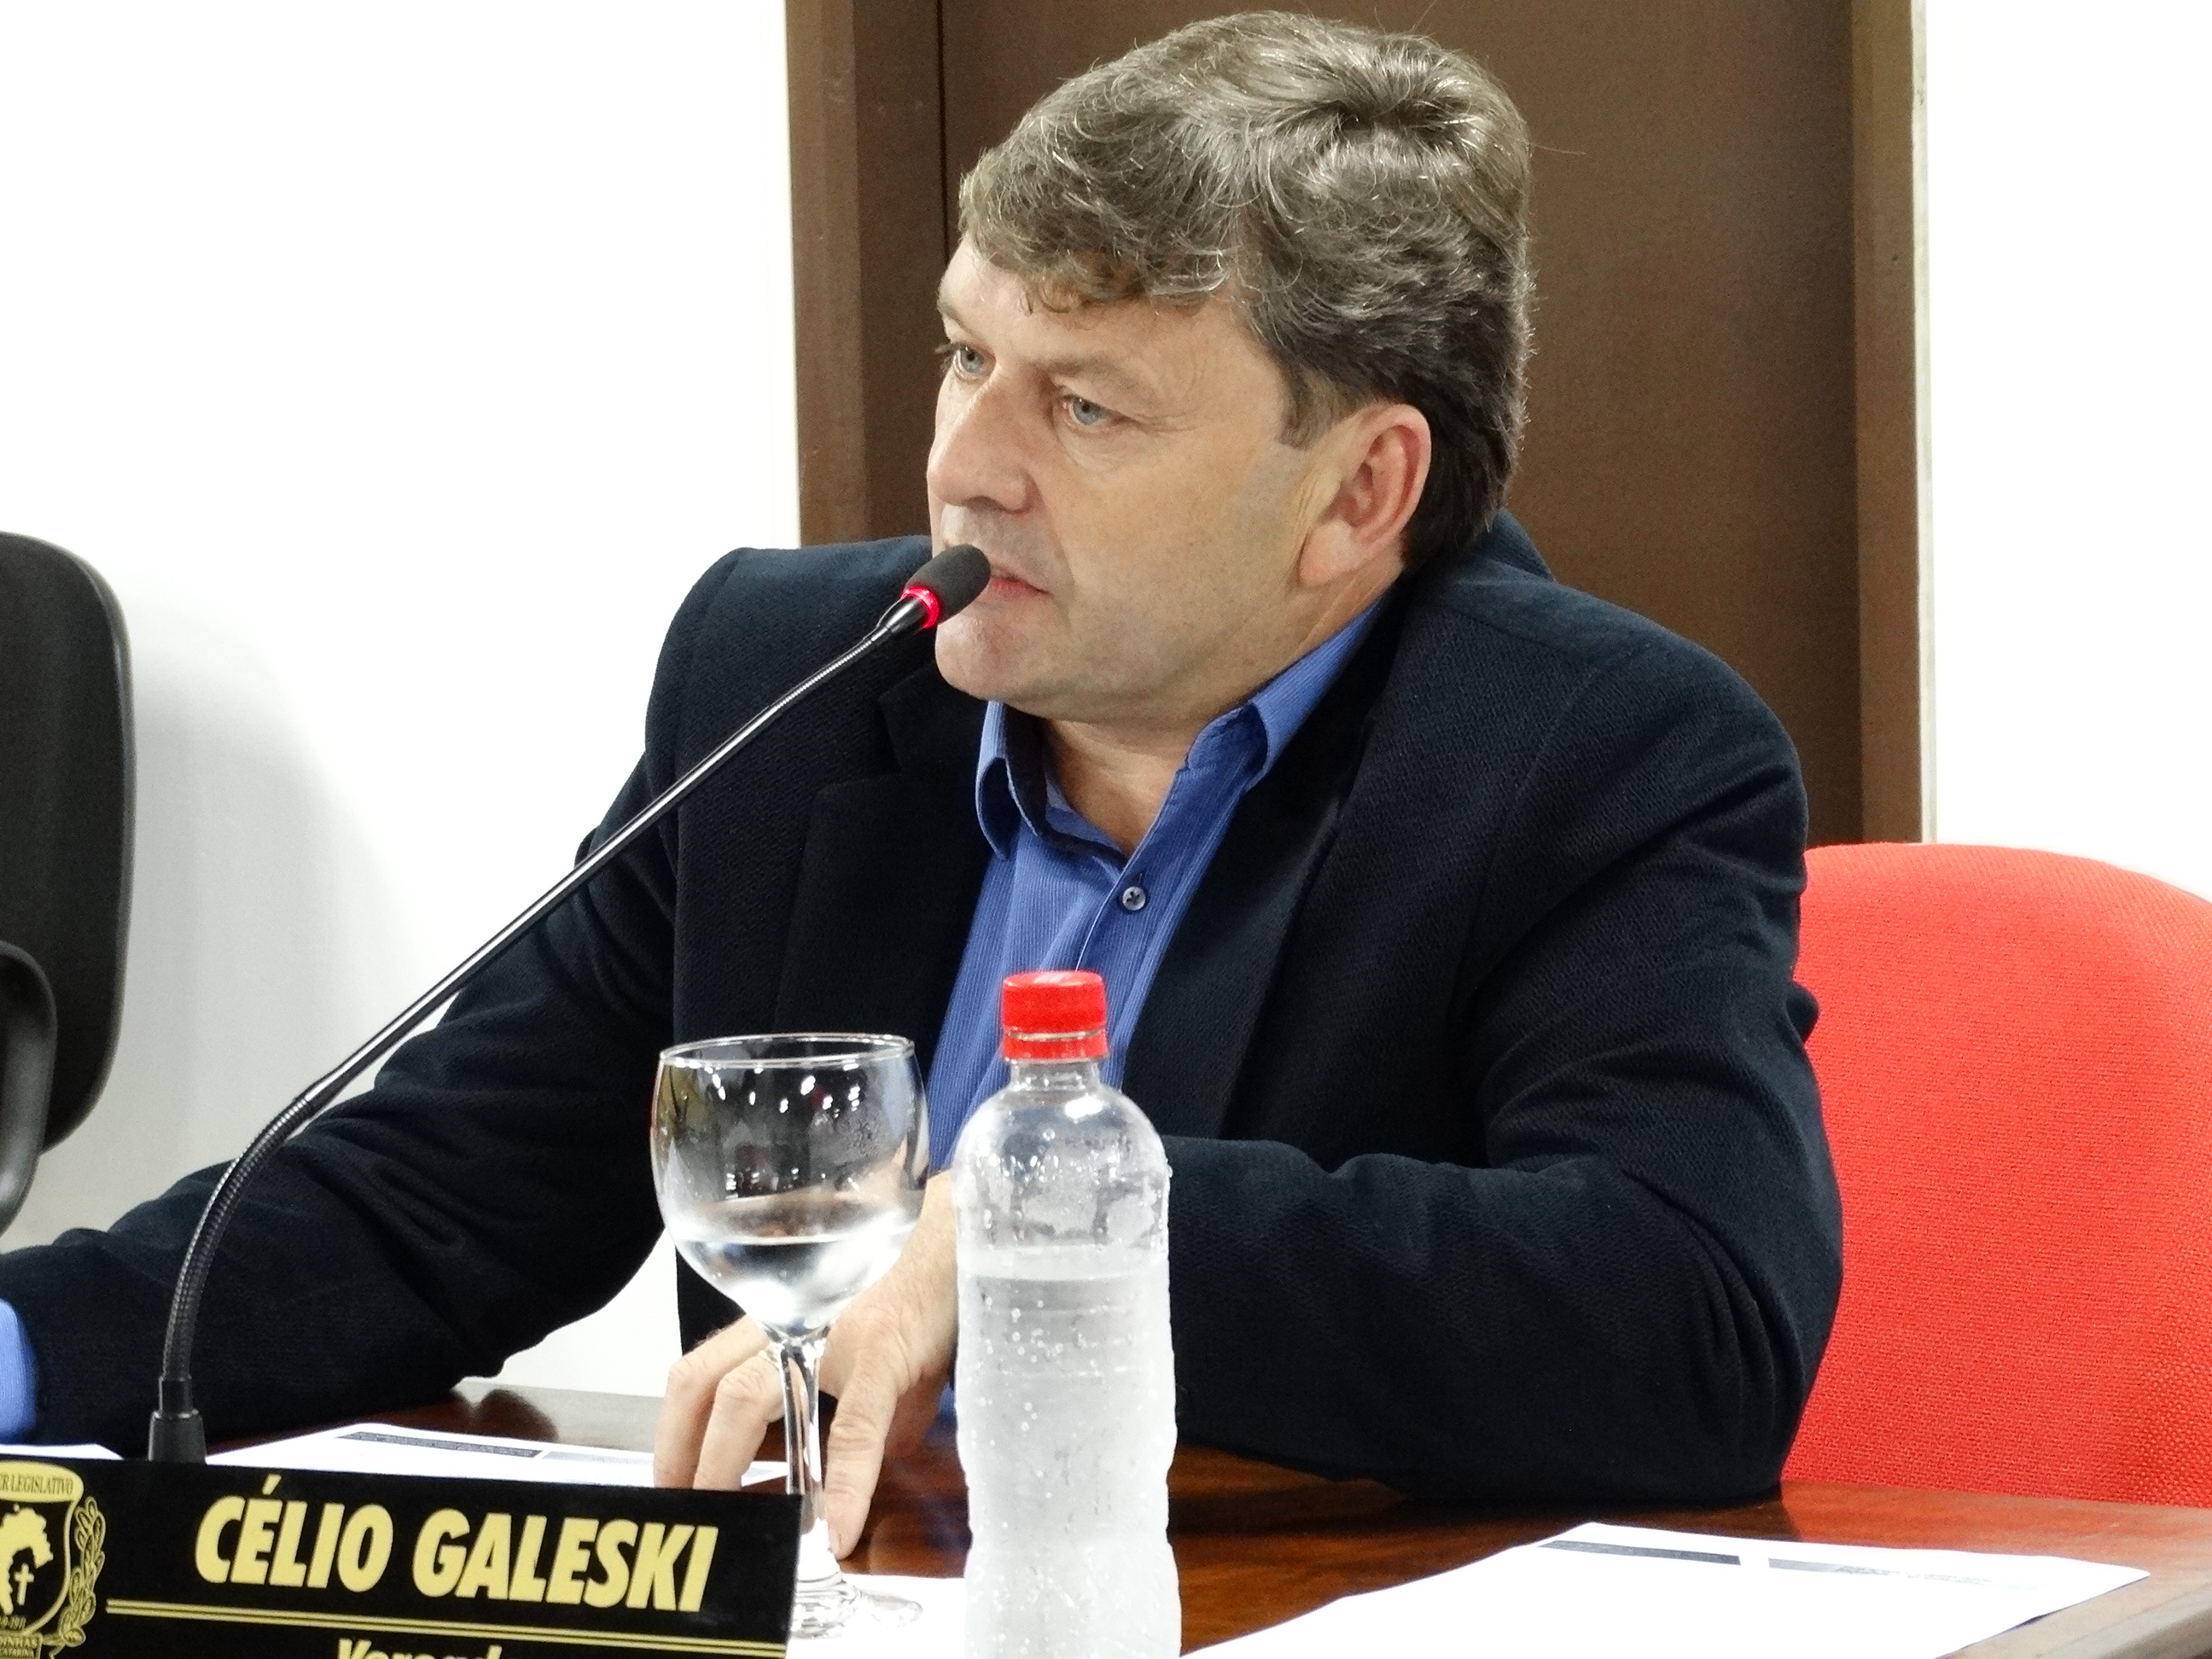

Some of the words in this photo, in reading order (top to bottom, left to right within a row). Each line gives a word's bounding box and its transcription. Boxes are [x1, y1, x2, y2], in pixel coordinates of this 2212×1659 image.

[10, 1474, 74, 1494] LEGISLATIVO
[195, 1474, 394, 1592] CÉLIO
[411, 1508, 719, 1613] GALESKI
